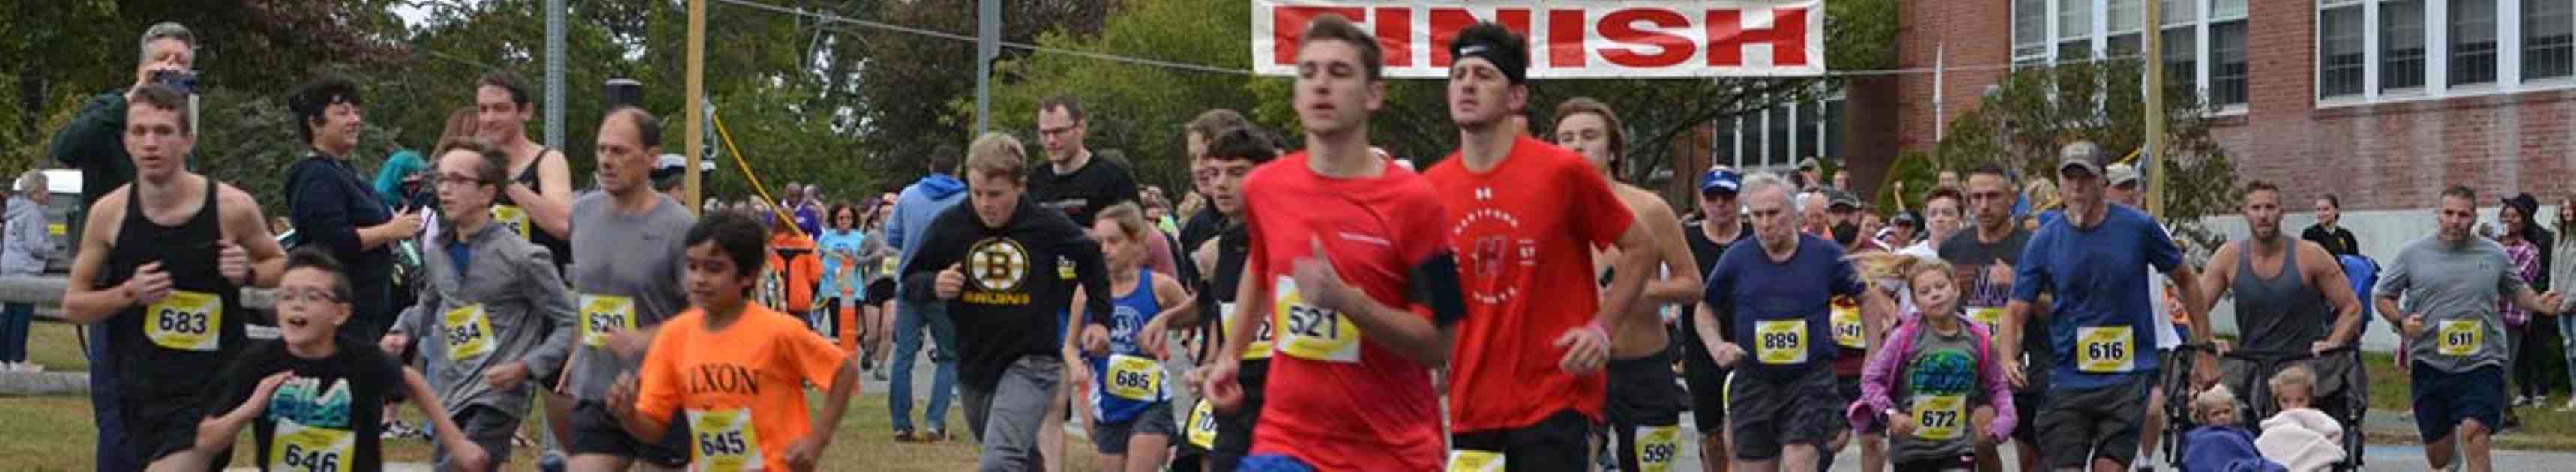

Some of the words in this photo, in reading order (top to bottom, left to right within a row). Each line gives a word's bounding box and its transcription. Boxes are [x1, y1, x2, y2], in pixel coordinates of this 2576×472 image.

[1274, 6, 1806, 68] FINISH
[160, 308, 206, 334] 683
[1289, 306, 1337, 340] 521
[1764, 332, 1798, 349] 889
[2089, 341, 2124, 360] 616
[2448, 331, 2473, 345] 611
[690, 363, 759, 395] IXON
[1116, 370, 1149, 390] 685
[1923, 411, 1957, 427] 672
[700, 430, 745, 456] 645
[286, 444, 339, 472] 646
